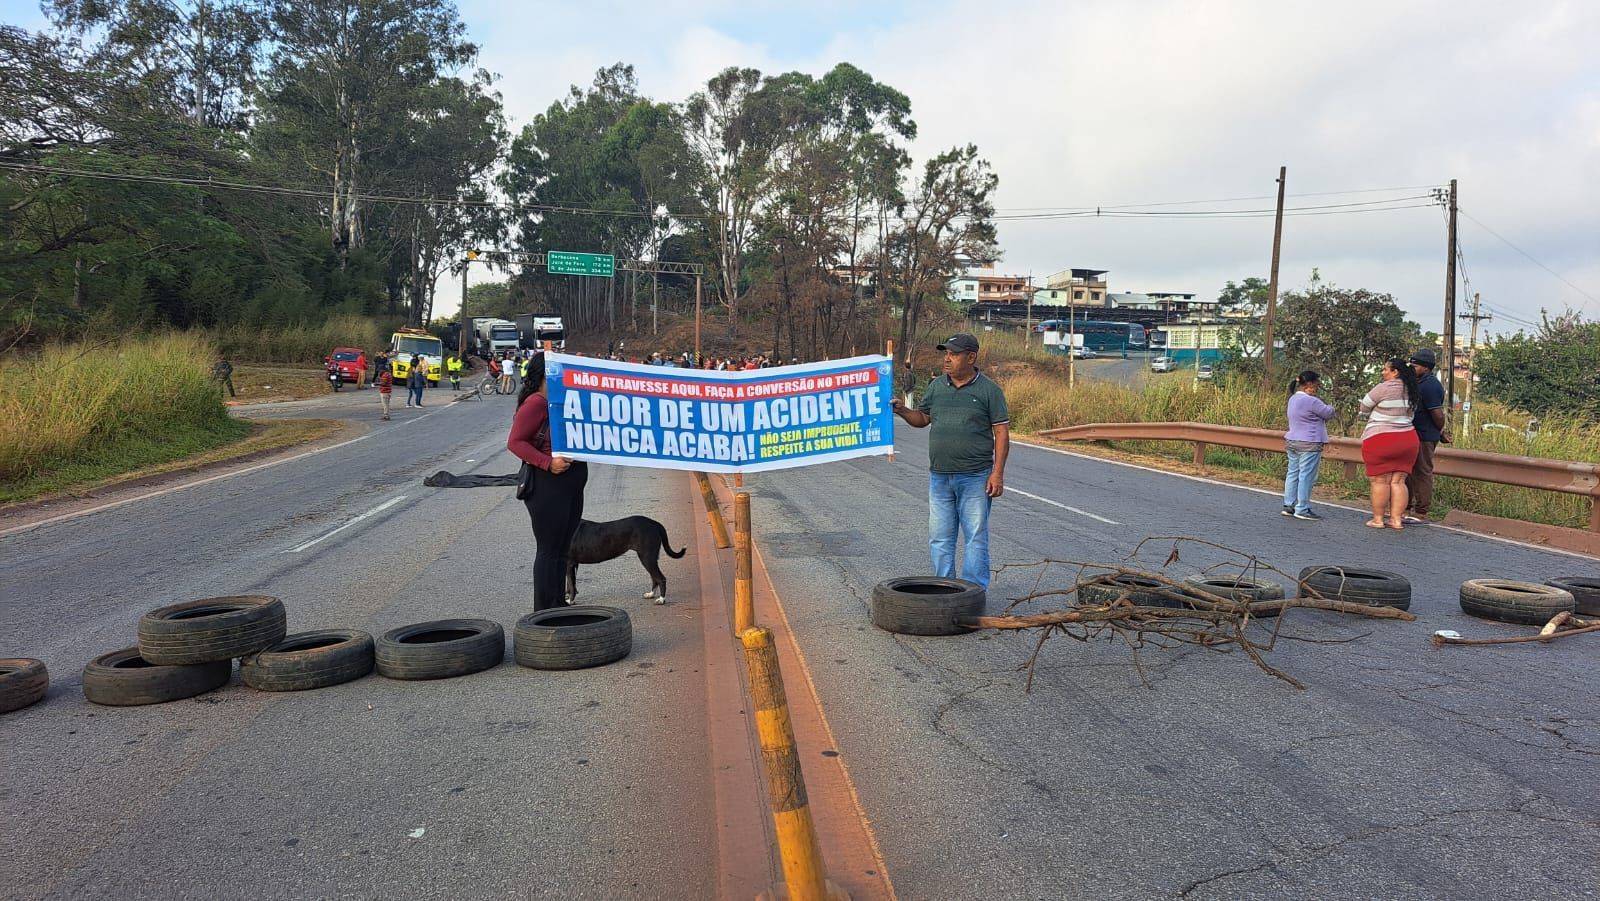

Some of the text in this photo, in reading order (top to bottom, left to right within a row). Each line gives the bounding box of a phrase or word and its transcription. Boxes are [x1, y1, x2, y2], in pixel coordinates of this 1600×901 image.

[573, 371, 598, 387] NÃO
[601, 376, 669, 394] ATRAVESSE
[705, 386, 734, 399] FAÇA
[736, 386, 744, 398] A
[746, 376, 814, 397] CONVERSÃO
[817, 376, 832, 388] NO
[835, 372, 870, 386] TREVO
[563, 386, 882, 433] A DOR DE UM ACIDENTE
[565, 421, 756, 462] NUNCA ACABA!
[760, 431, 779, 446] NÃO
[780, 429, 802, 442] SEJA
[760, 443, 804, 458] RESPEITE
[806, 442, 812, 452] A
[814, 438, 834, 450] SUA
